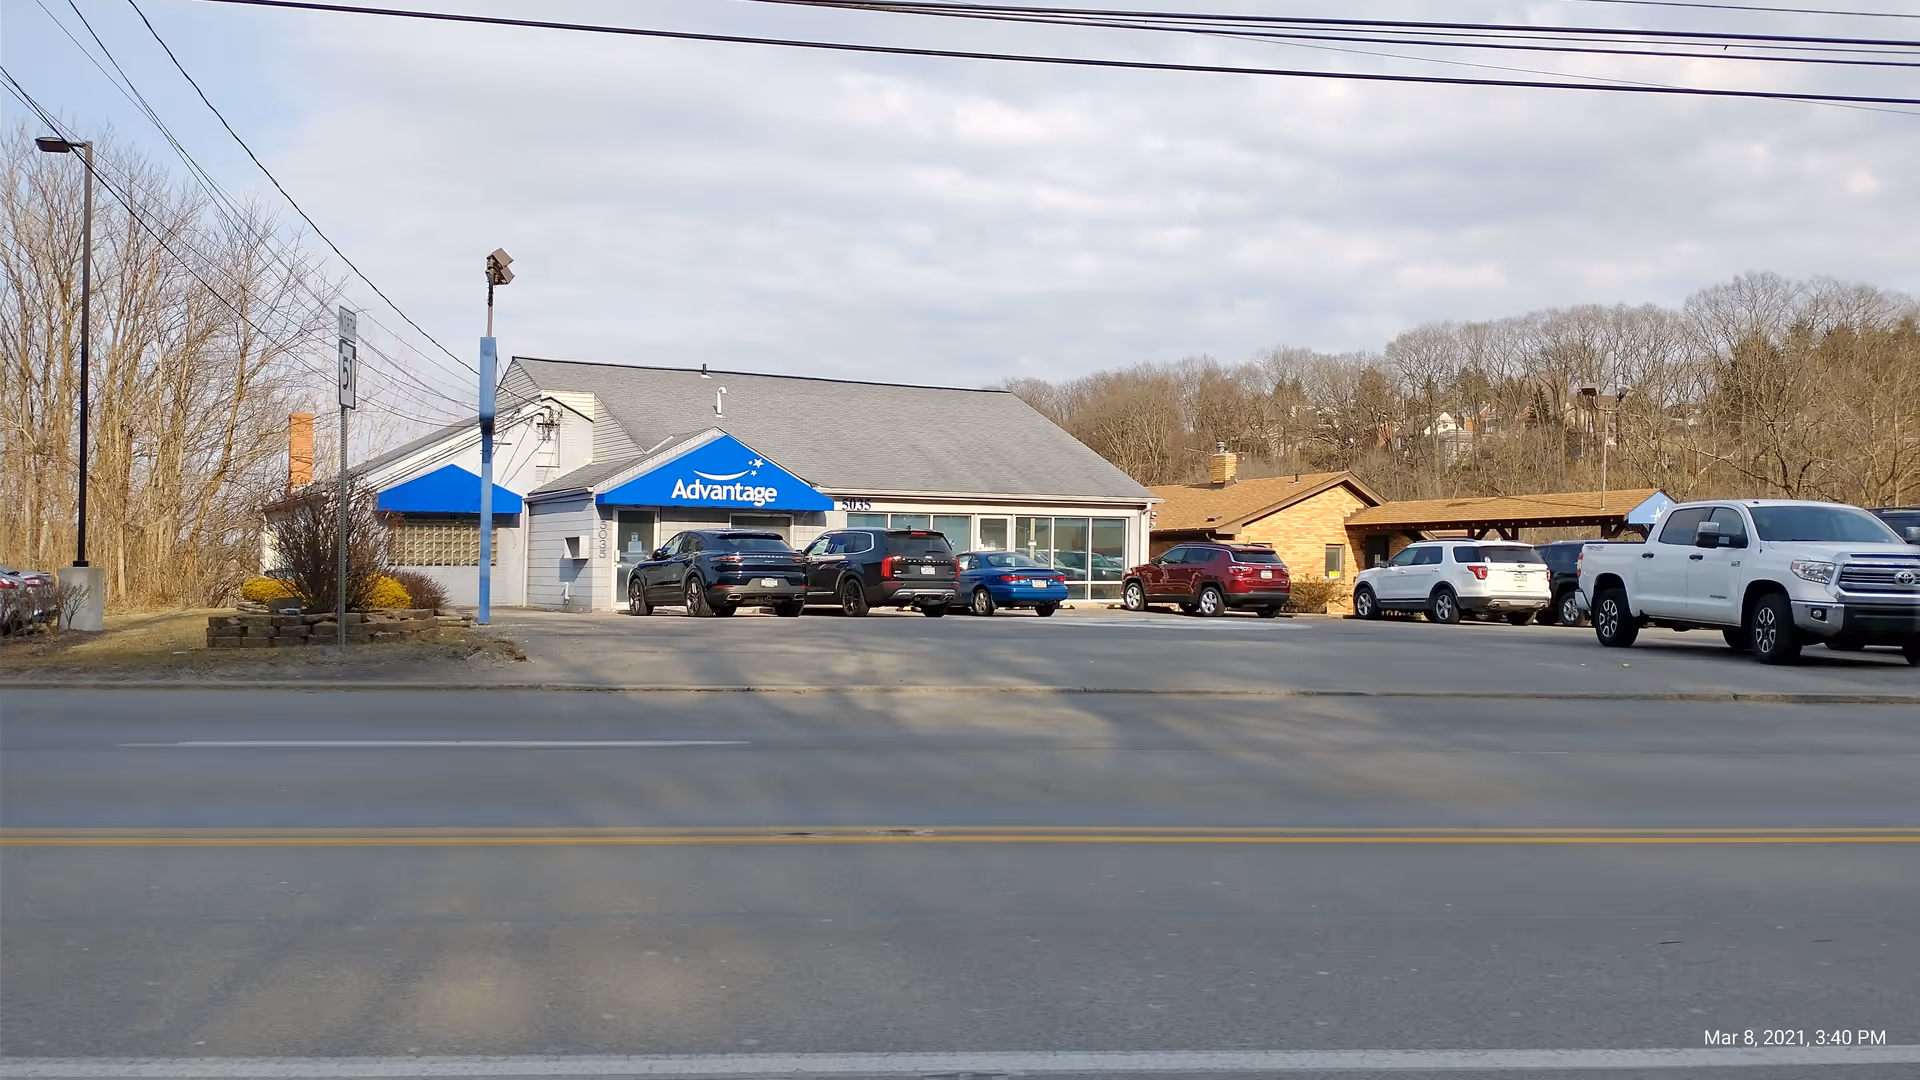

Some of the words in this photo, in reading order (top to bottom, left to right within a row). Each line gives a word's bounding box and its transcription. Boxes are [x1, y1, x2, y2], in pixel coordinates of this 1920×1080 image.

[343, 356, 352, 391] 51
[671, 478, 777, 507] Advantage
[842, 498, 872, 512] 5035
